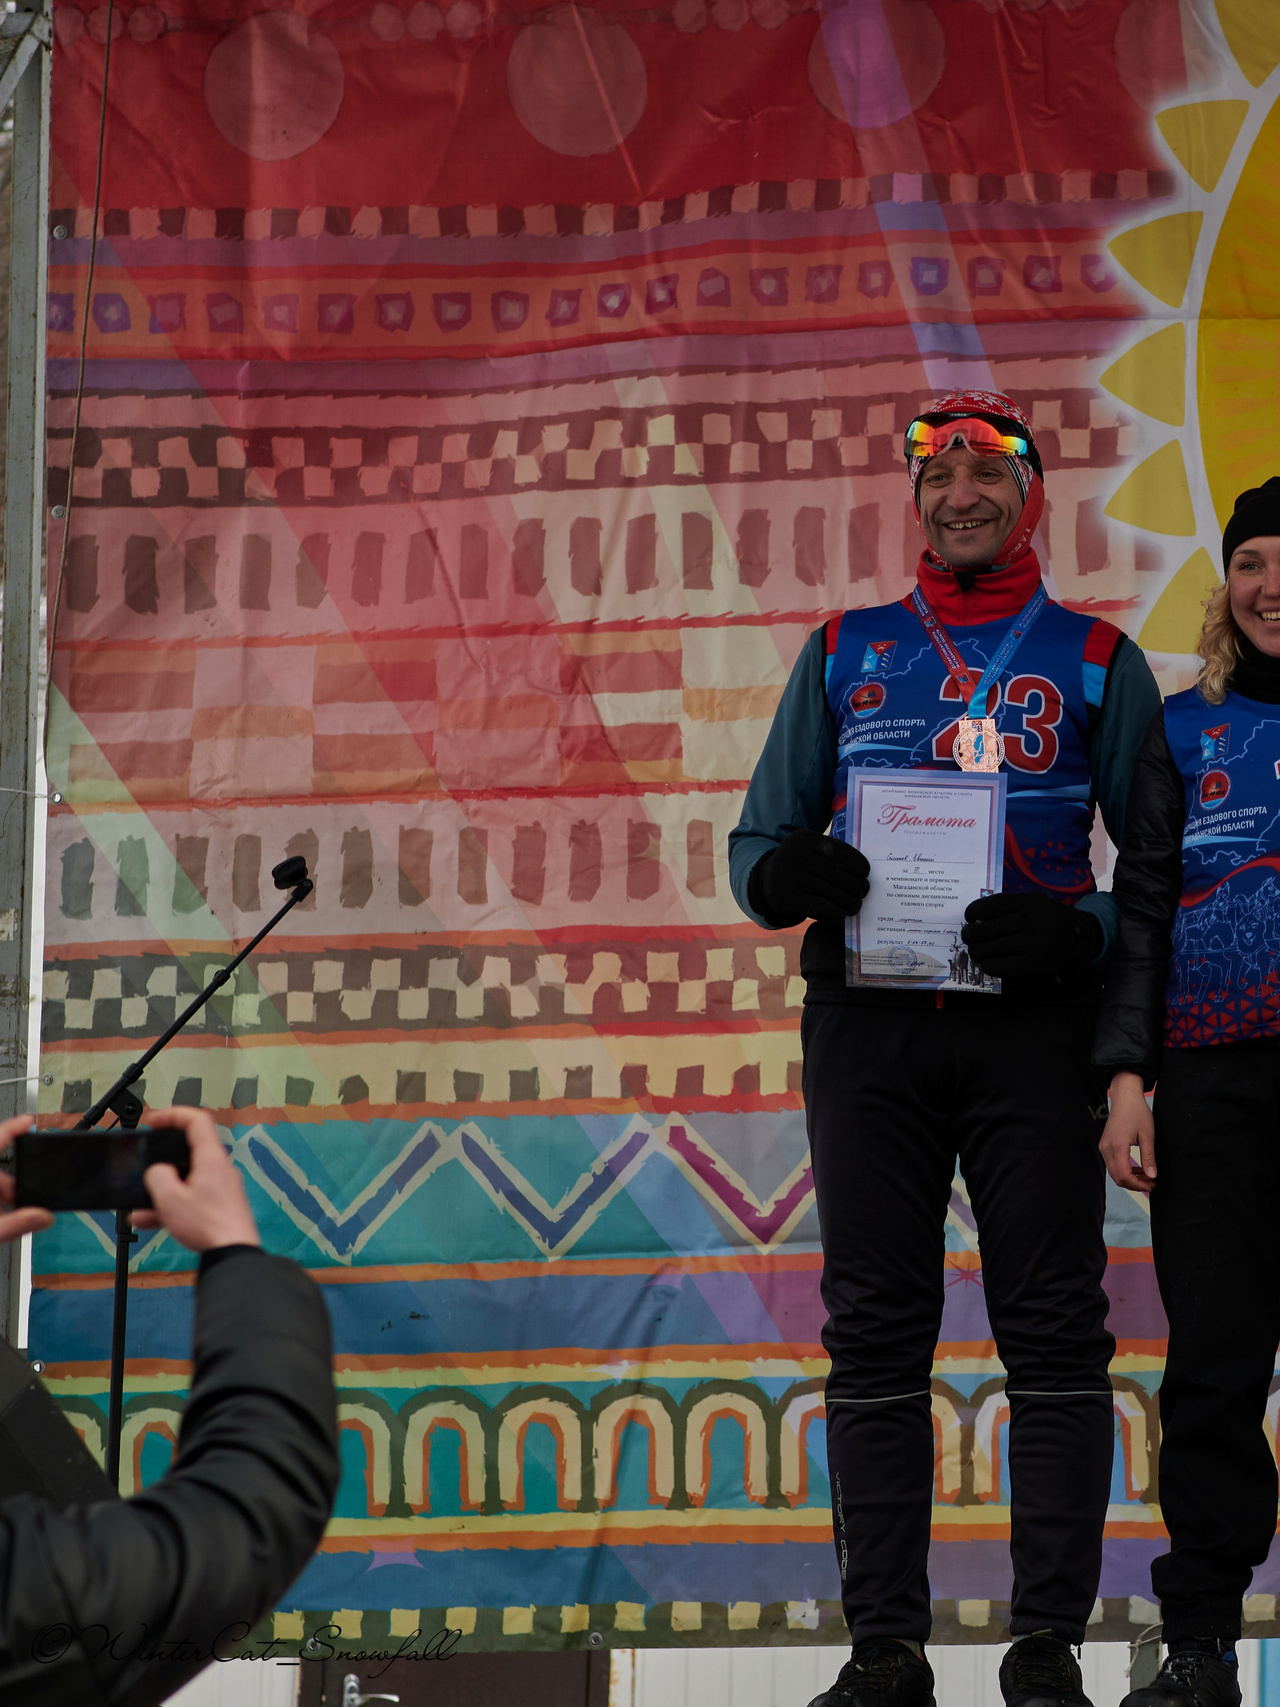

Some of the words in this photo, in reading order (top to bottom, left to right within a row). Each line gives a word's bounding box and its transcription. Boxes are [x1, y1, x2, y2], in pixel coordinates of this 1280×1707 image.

[855, 720, 891, 733] ЕЗДОВОГО
[893, 719, 926, 727] СПОРТА
[931, 667, 1064, 775] 23
[873, 730, 910, 740] ОБЛАСТИ
[877, 803, 977, 833] Грамота
[1203, 810, 1237, 825] ЕЗДОВОГО
[1238, 806, 1267, 817] СПОРТА
[1222, 820, 1254, 833] ОБЛАСТИ
[835, 1472, 846, 1533] VICTORY
